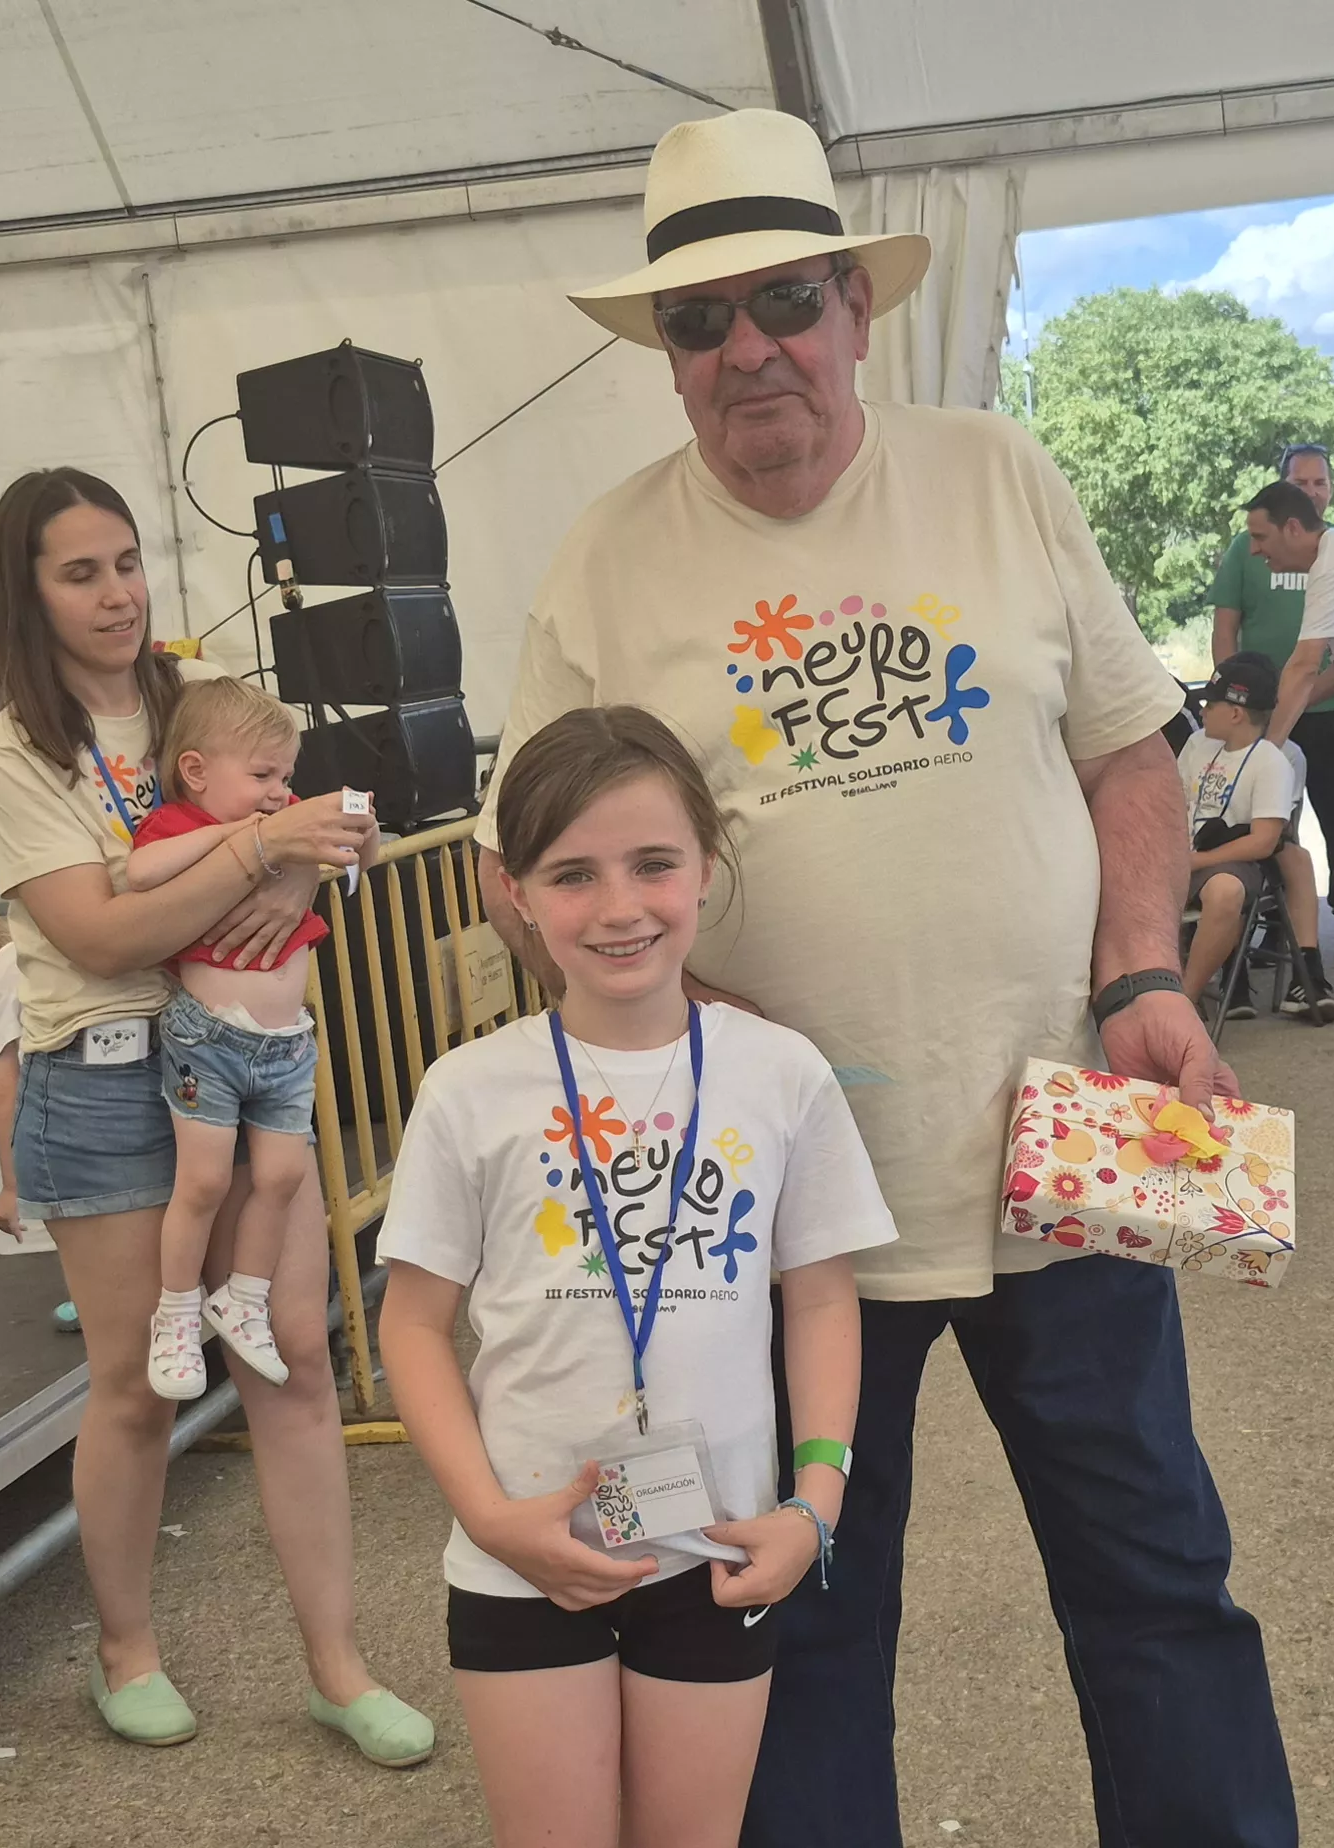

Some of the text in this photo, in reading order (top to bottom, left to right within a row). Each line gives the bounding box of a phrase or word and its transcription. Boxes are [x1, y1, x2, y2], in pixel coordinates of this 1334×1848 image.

[1270, 572, 1309, 591] PUM
[771, 688, 930, 760] FEST
[759, 792, 777, 805] III
[780, 774, 845, 800] FESTIVAL
[848, 757, 930, 784] SOLIDARIO
[545, 1288, 562, 1300] III
[632, 1288, 706, 1300] SOIDARIO
[636, 1476, 696, 1498] ORGANIZACIÓN
